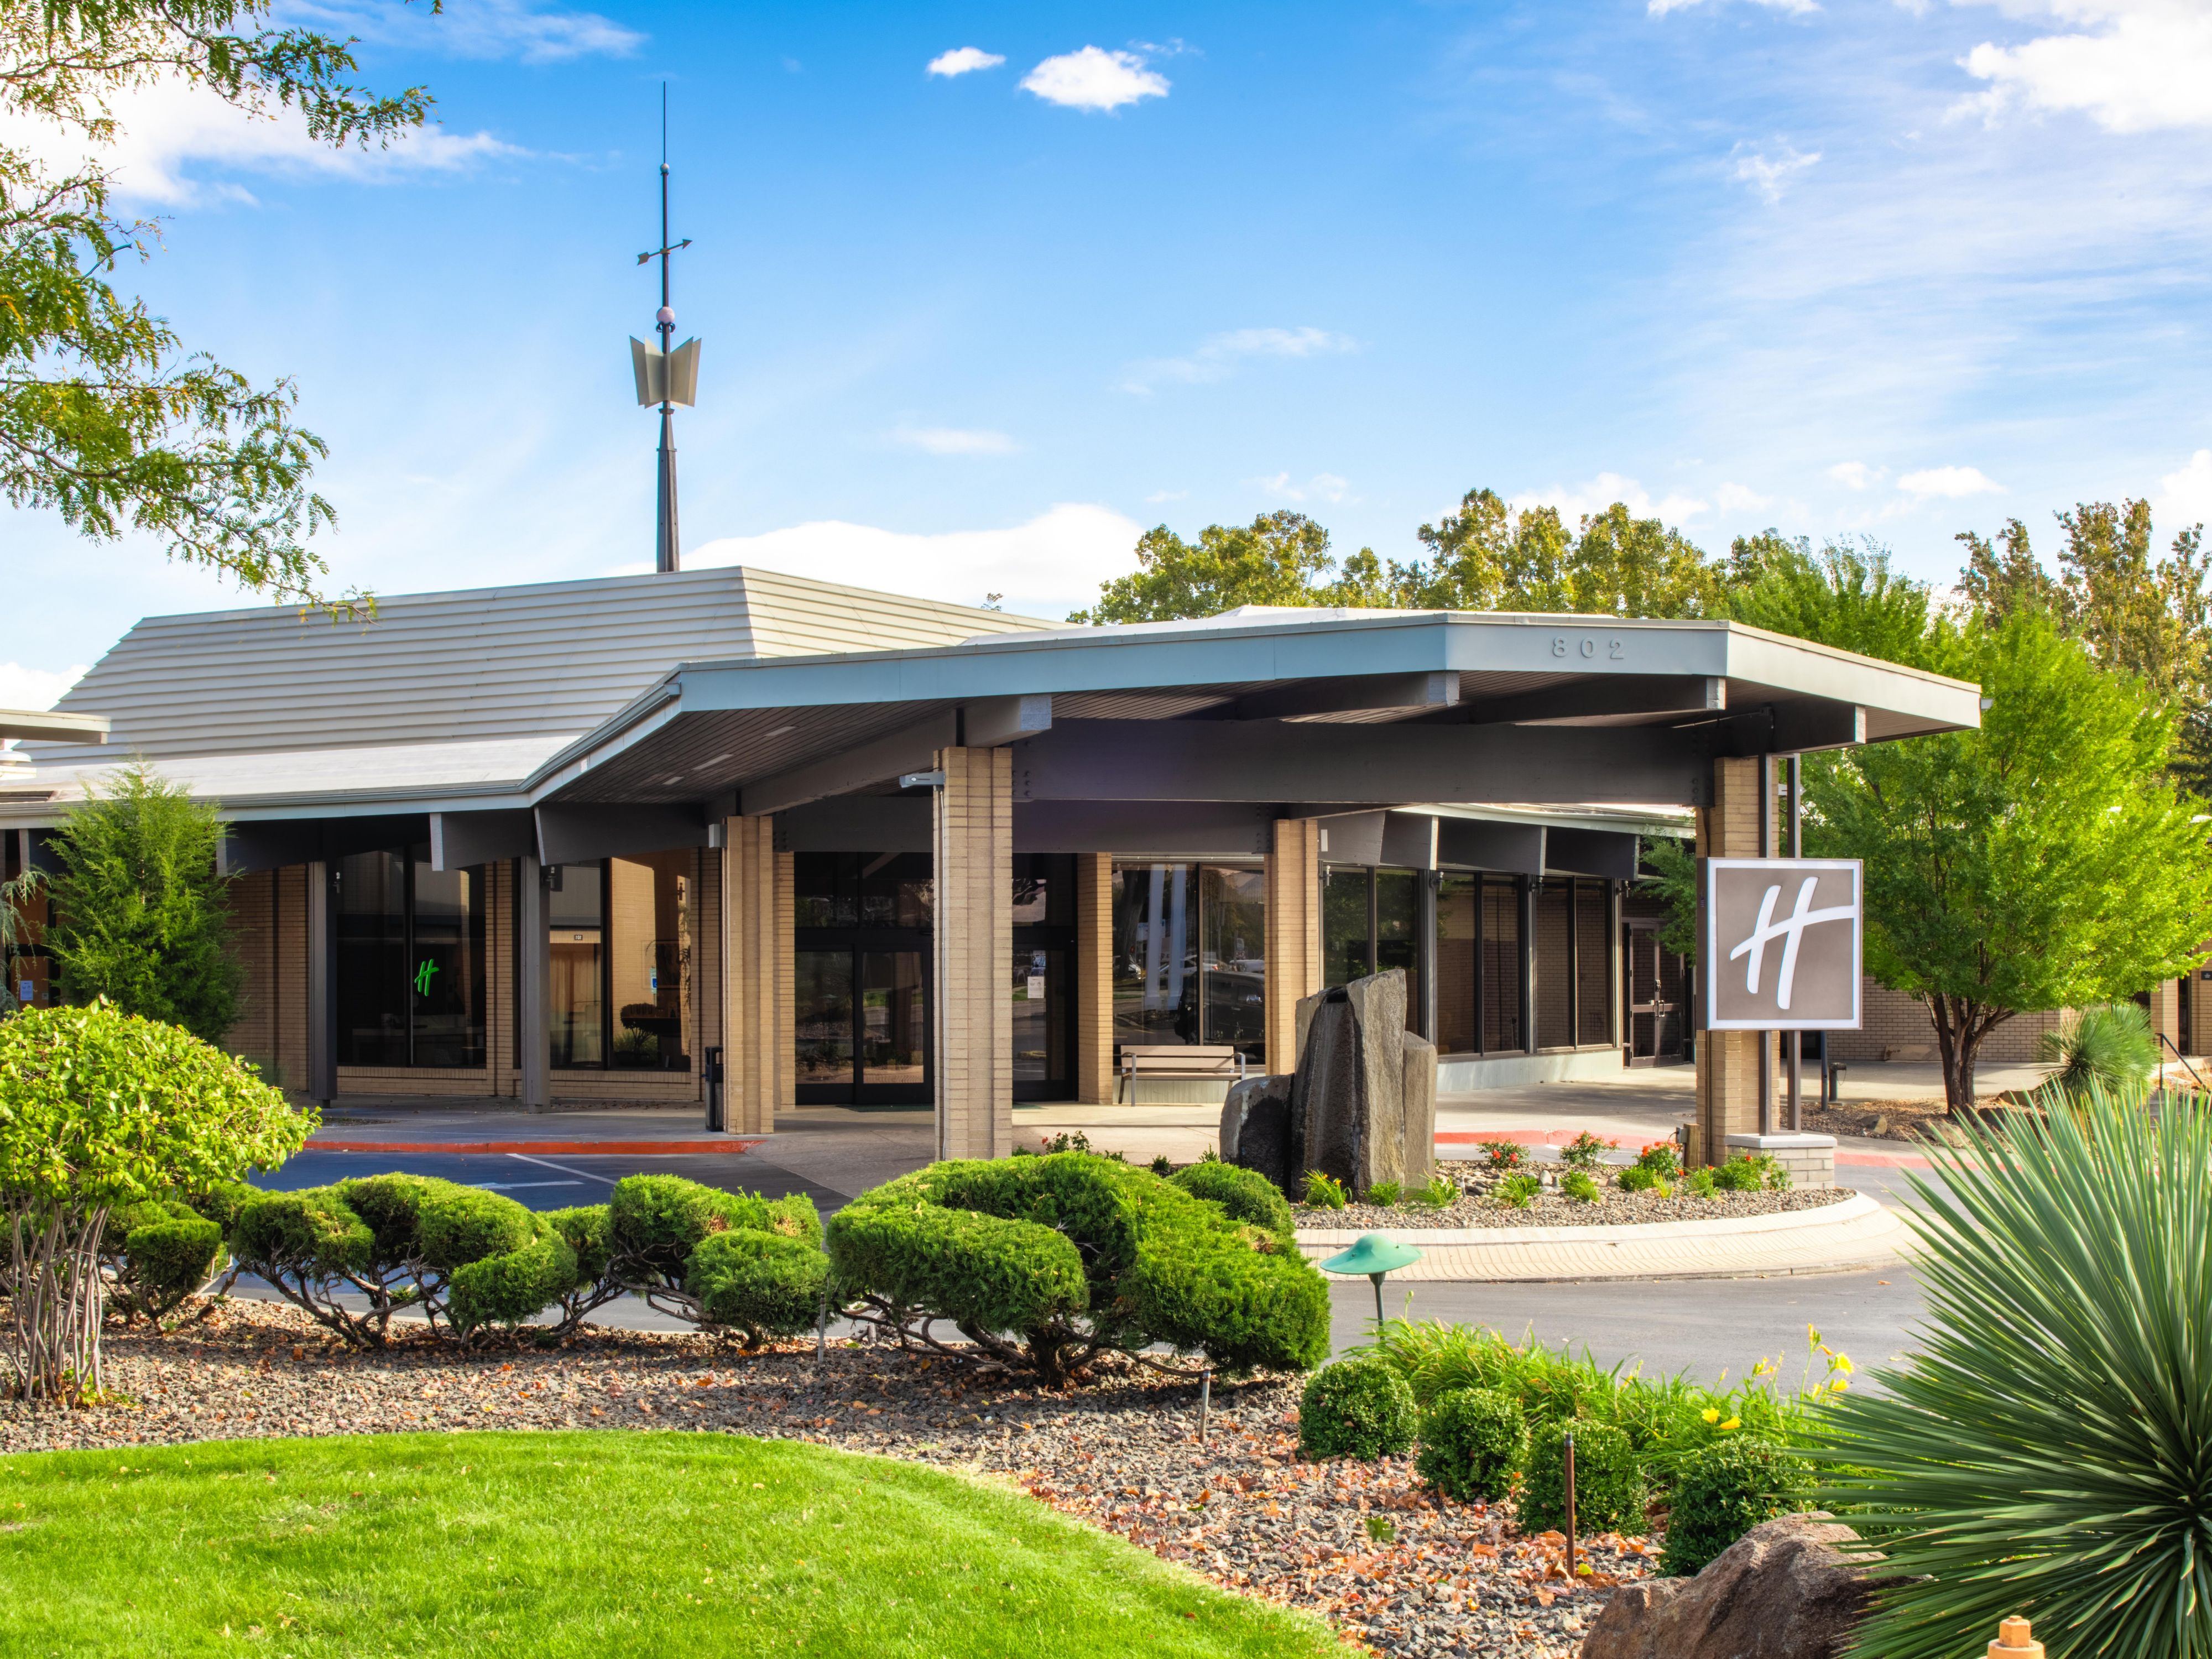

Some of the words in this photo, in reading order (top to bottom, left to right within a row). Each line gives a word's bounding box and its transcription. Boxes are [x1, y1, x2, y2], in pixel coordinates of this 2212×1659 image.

[1553, 637, 1624, 659] 802
[1730, 877, 1854, 1009] H
[414, 958, 439, 997] H
